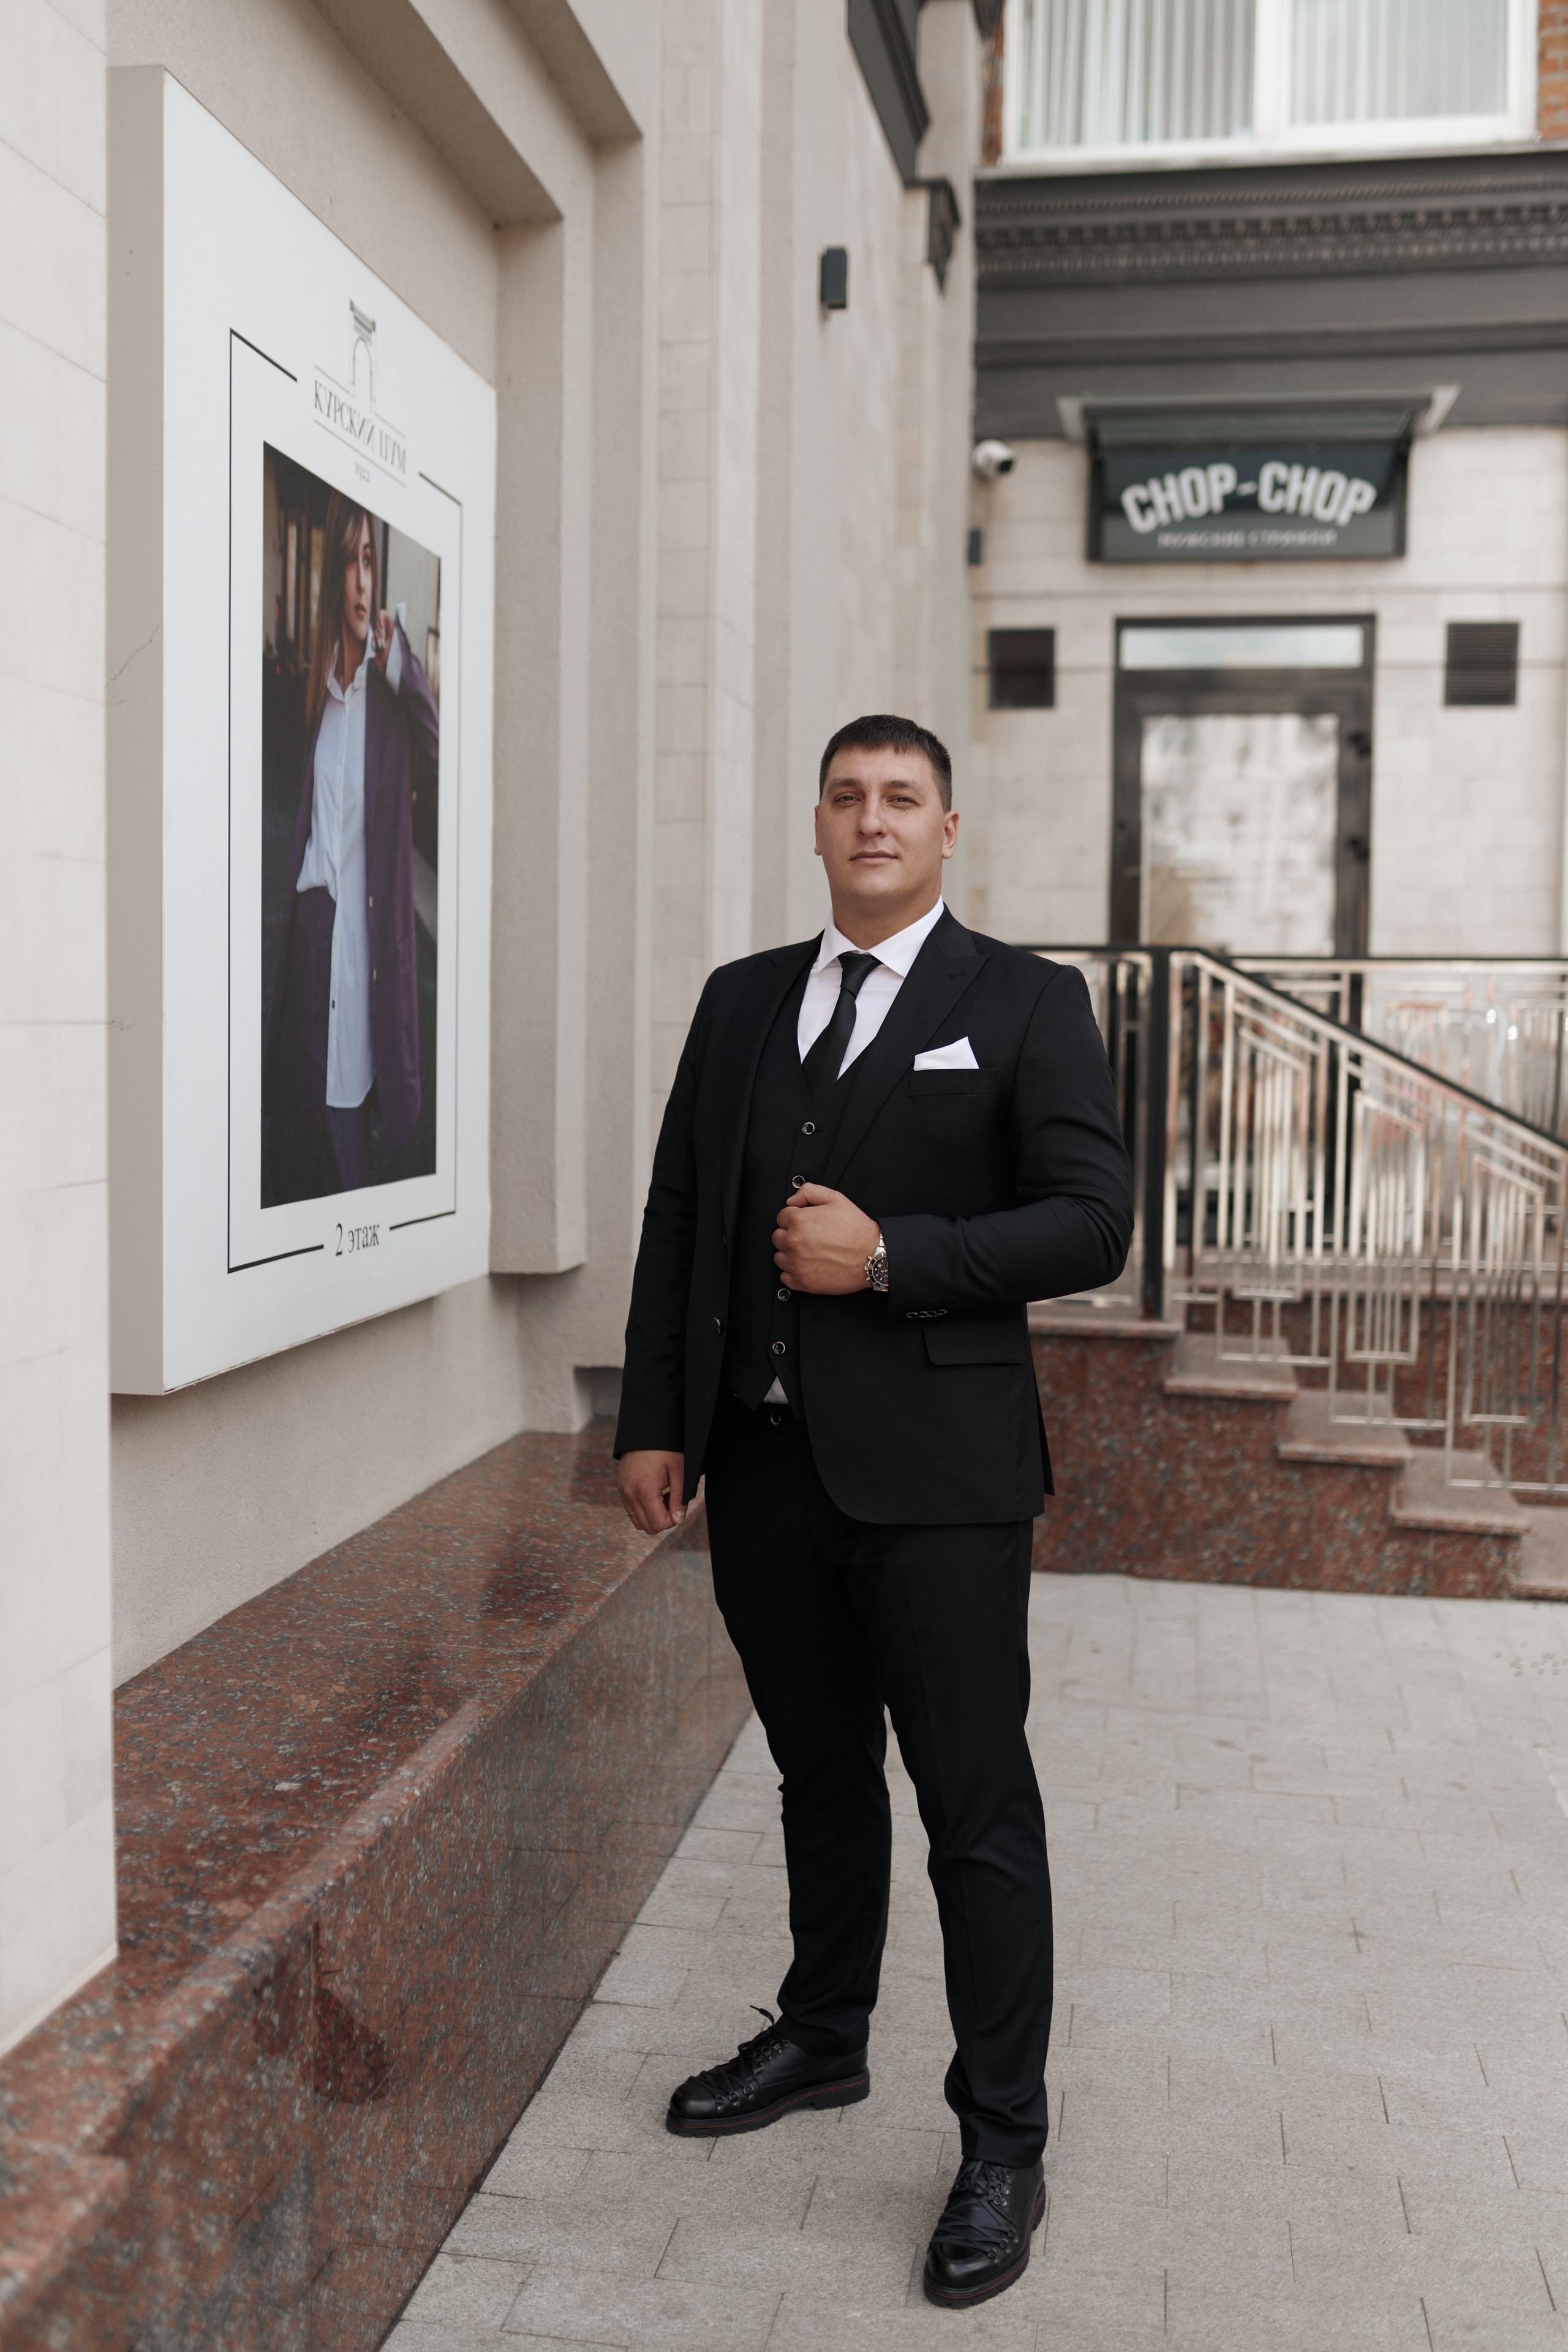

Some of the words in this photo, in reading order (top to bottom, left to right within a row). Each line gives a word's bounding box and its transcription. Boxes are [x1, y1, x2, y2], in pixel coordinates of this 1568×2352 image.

[314, 379, 375, 451] КУРСКИЙ
[379, 429, 407, 475] ЦУМ
[355, 462, 371, 483] 1922
[1120, 461, 1377, 533] CHOP-CHOP
[335, 1223, 343, 1256] 2
[347, 1224, 380, 1254] этаж
